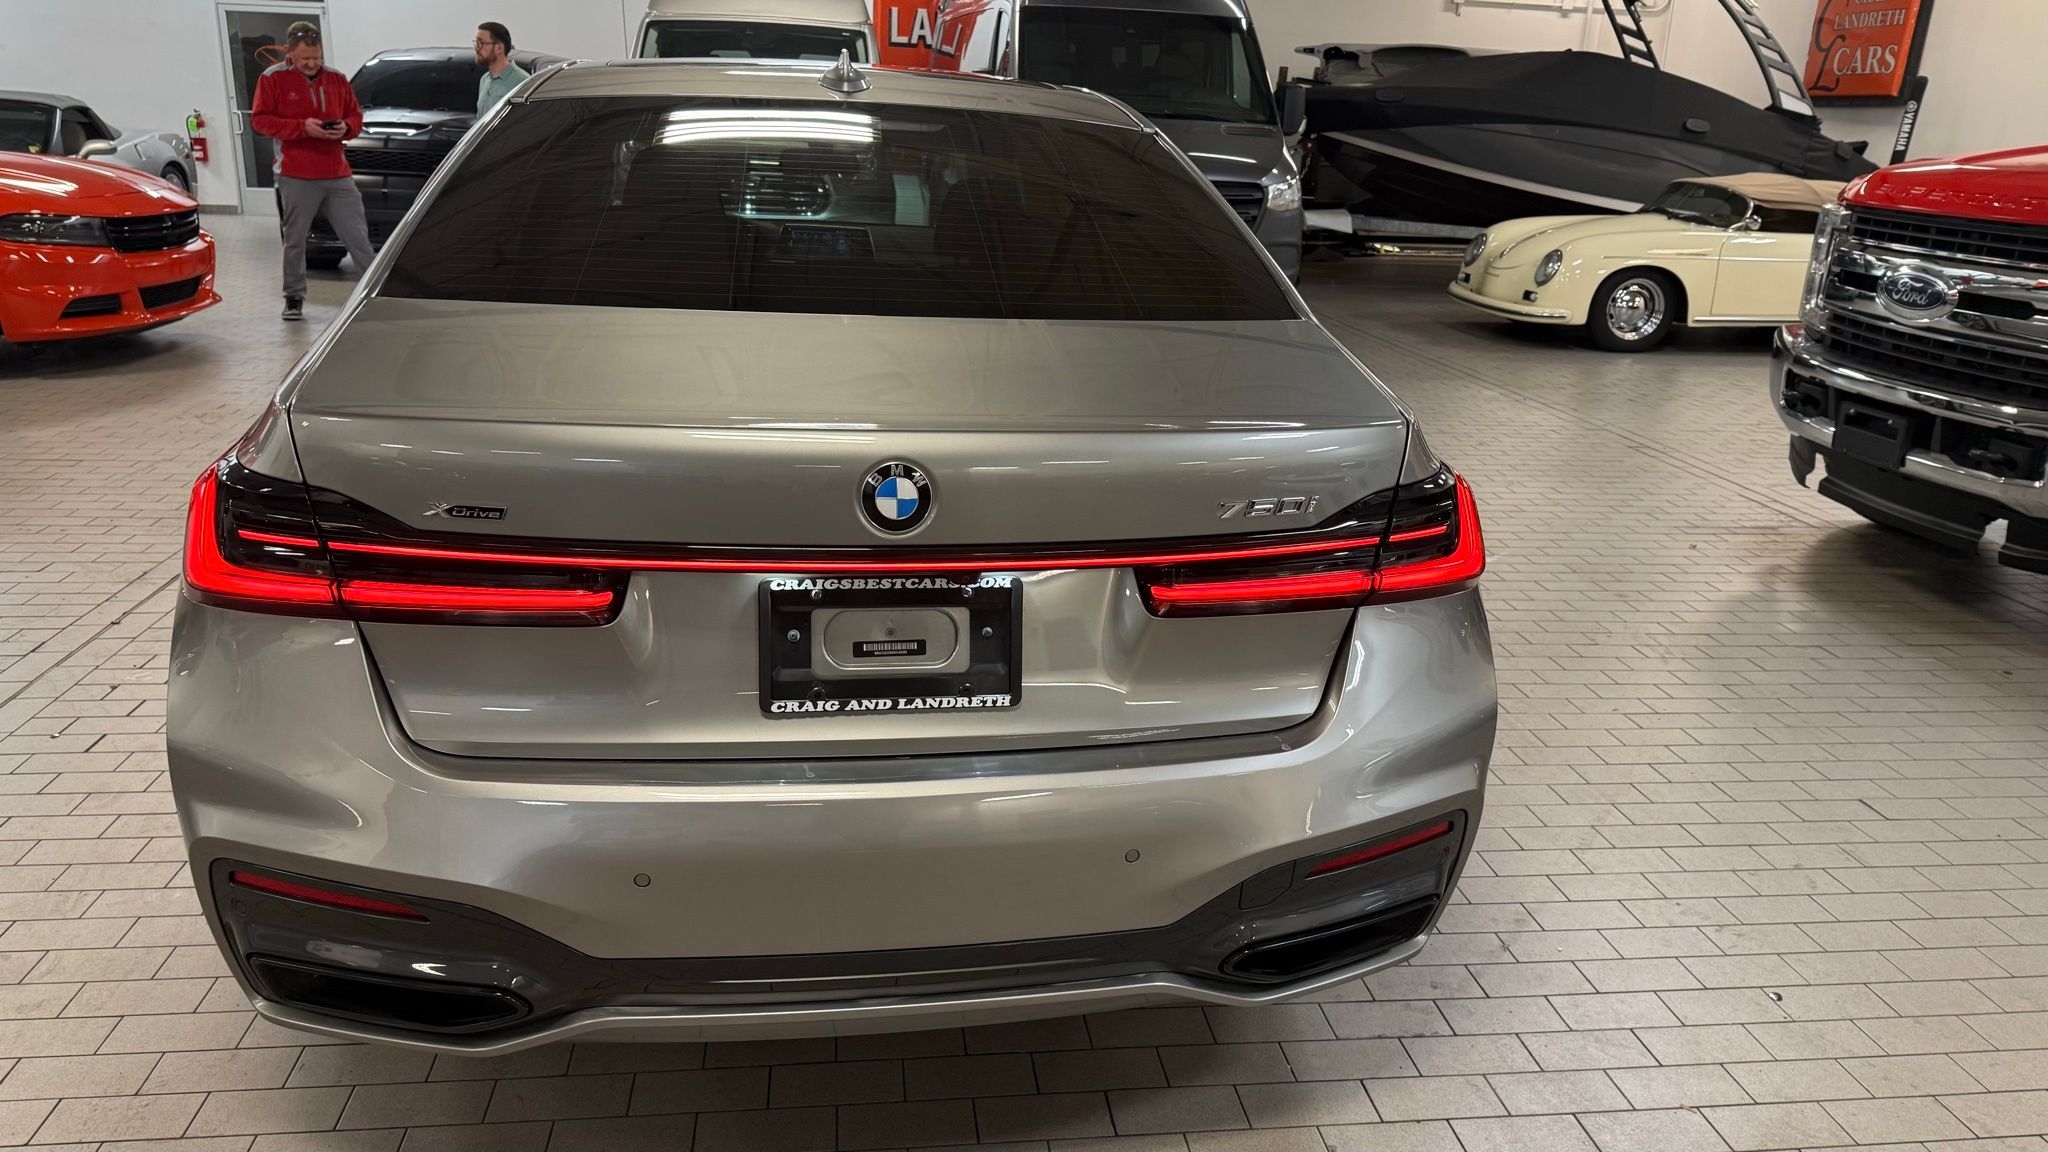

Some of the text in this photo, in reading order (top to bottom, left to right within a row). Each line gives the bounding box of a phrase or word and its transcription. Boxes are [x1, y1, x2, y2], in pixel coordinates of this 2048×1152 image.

[1833, 9, 1906, 30] LANDRETH
[1833, 45, 1898, 75] CARS
[1895, 112, 1915, 151] YAMAHA
[1892, 277, 1931, 305] Ford
[867, 464, 927, 487] BMW
[1219, 496, 1319, 519] 750i
[771, 694, 1012, 713] CRAIG AND LANDRETH
